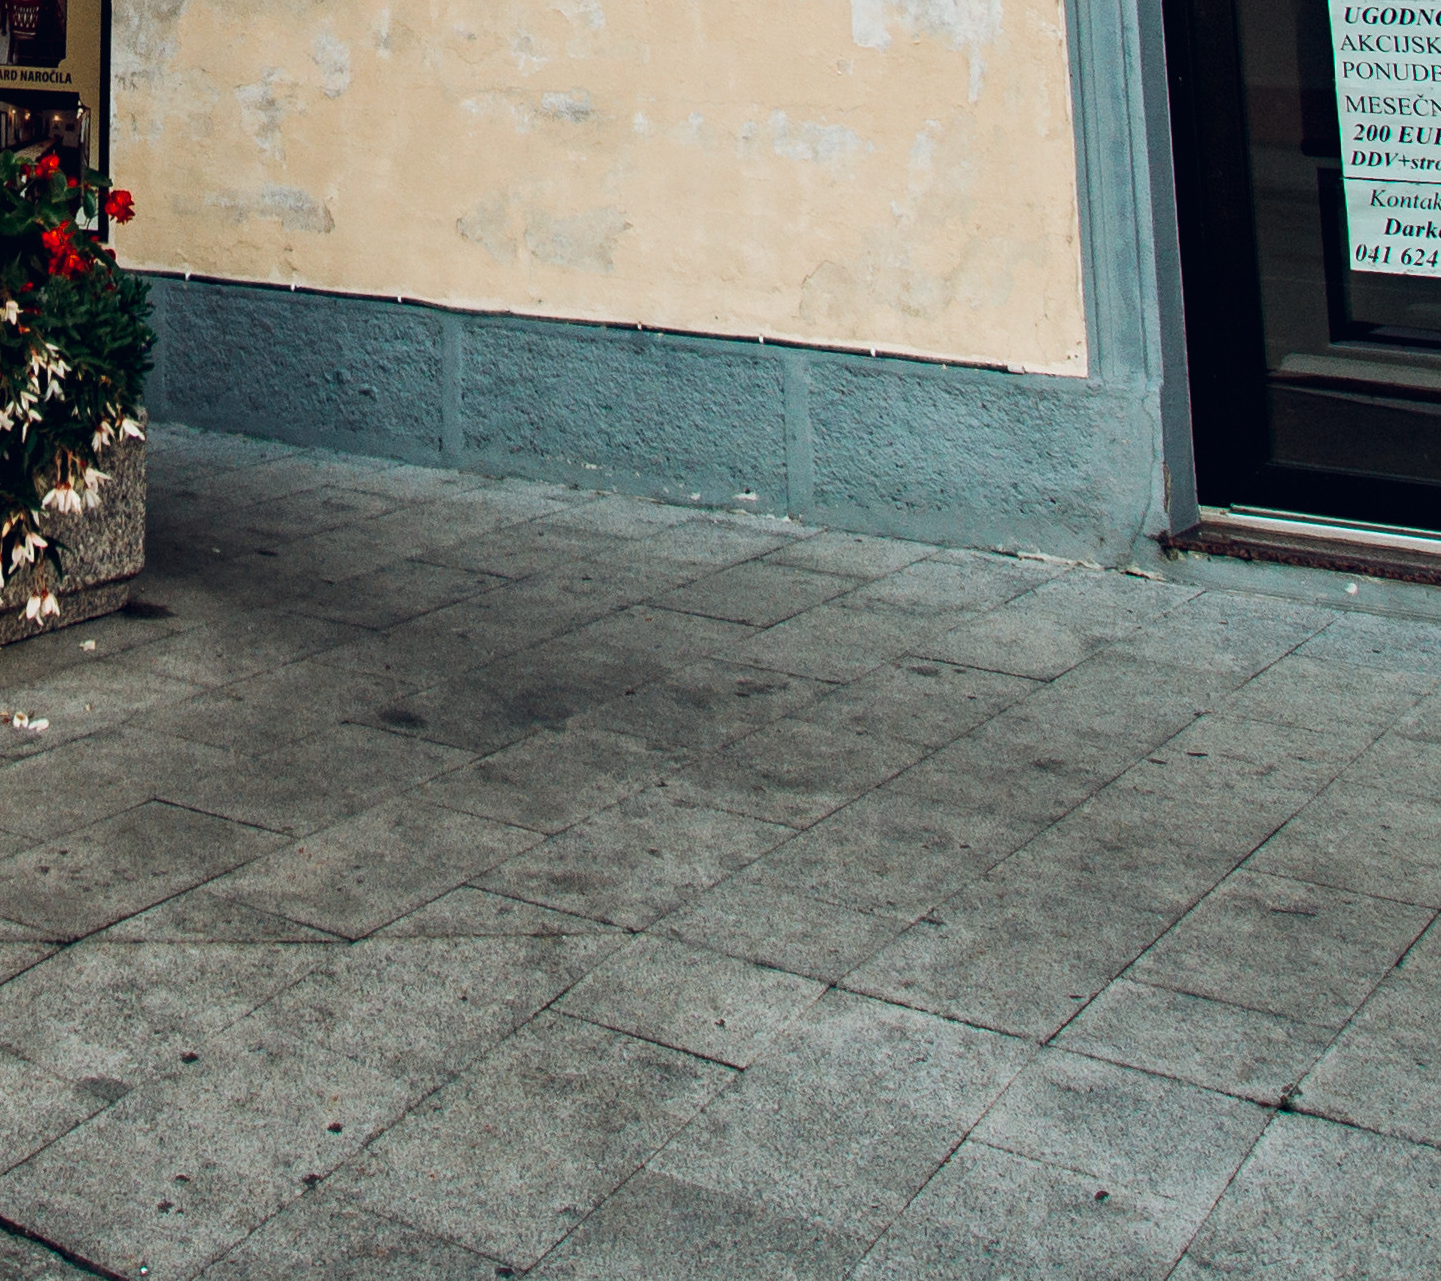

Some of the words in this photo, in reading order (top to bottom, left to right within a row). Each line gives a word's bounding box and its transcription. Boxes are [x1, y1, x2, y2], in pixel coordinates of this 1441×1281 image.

[20, 70, 73, 84] NAROČILA
[1353, 124, 1391, 144] 200
[1355, 245, 1391, 265] 041
[1400, 248, 1439, 268] 624
